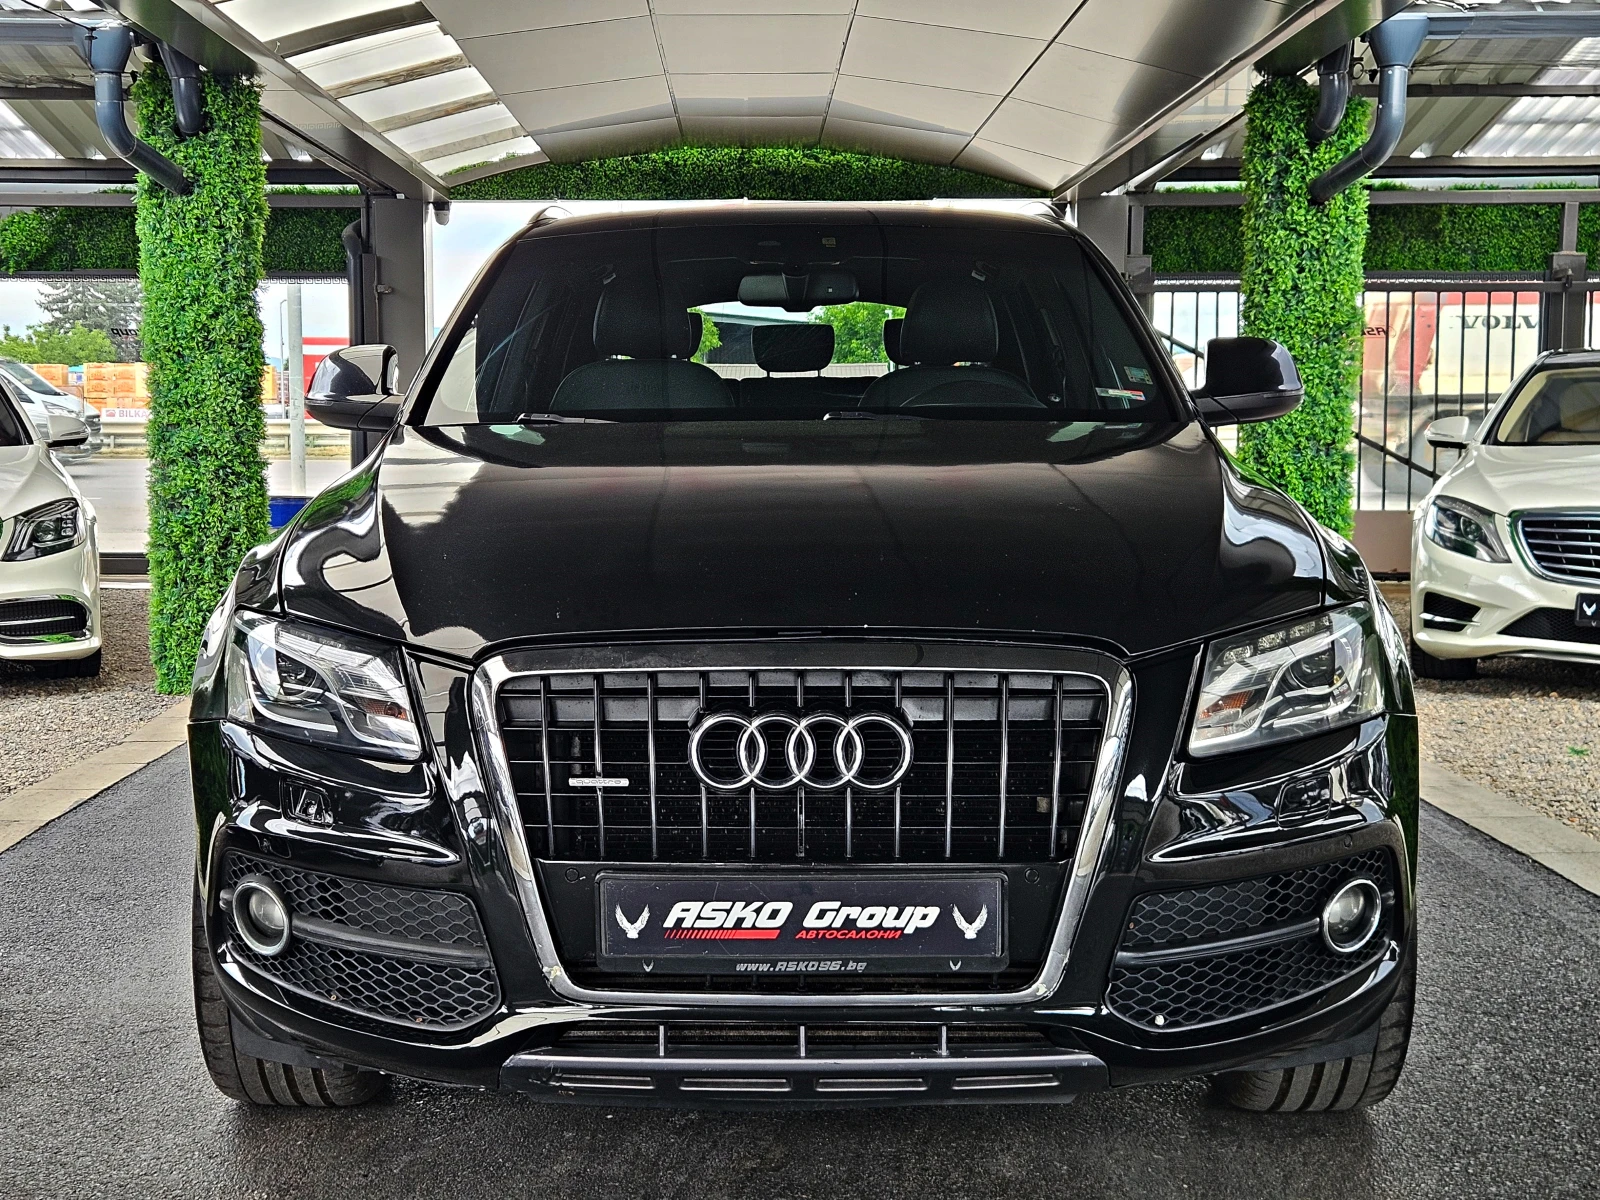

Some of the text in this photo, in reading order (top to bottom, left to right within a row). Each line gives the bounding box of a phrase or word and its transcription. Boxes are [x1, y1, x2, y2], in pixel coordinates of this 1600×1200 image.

[663, 901, 940, 934] ASKO Group
[795, 929, 902, 939] АВТОСАЛОНИ
[736, 960, 867, 973] www.ASKO96.bg
